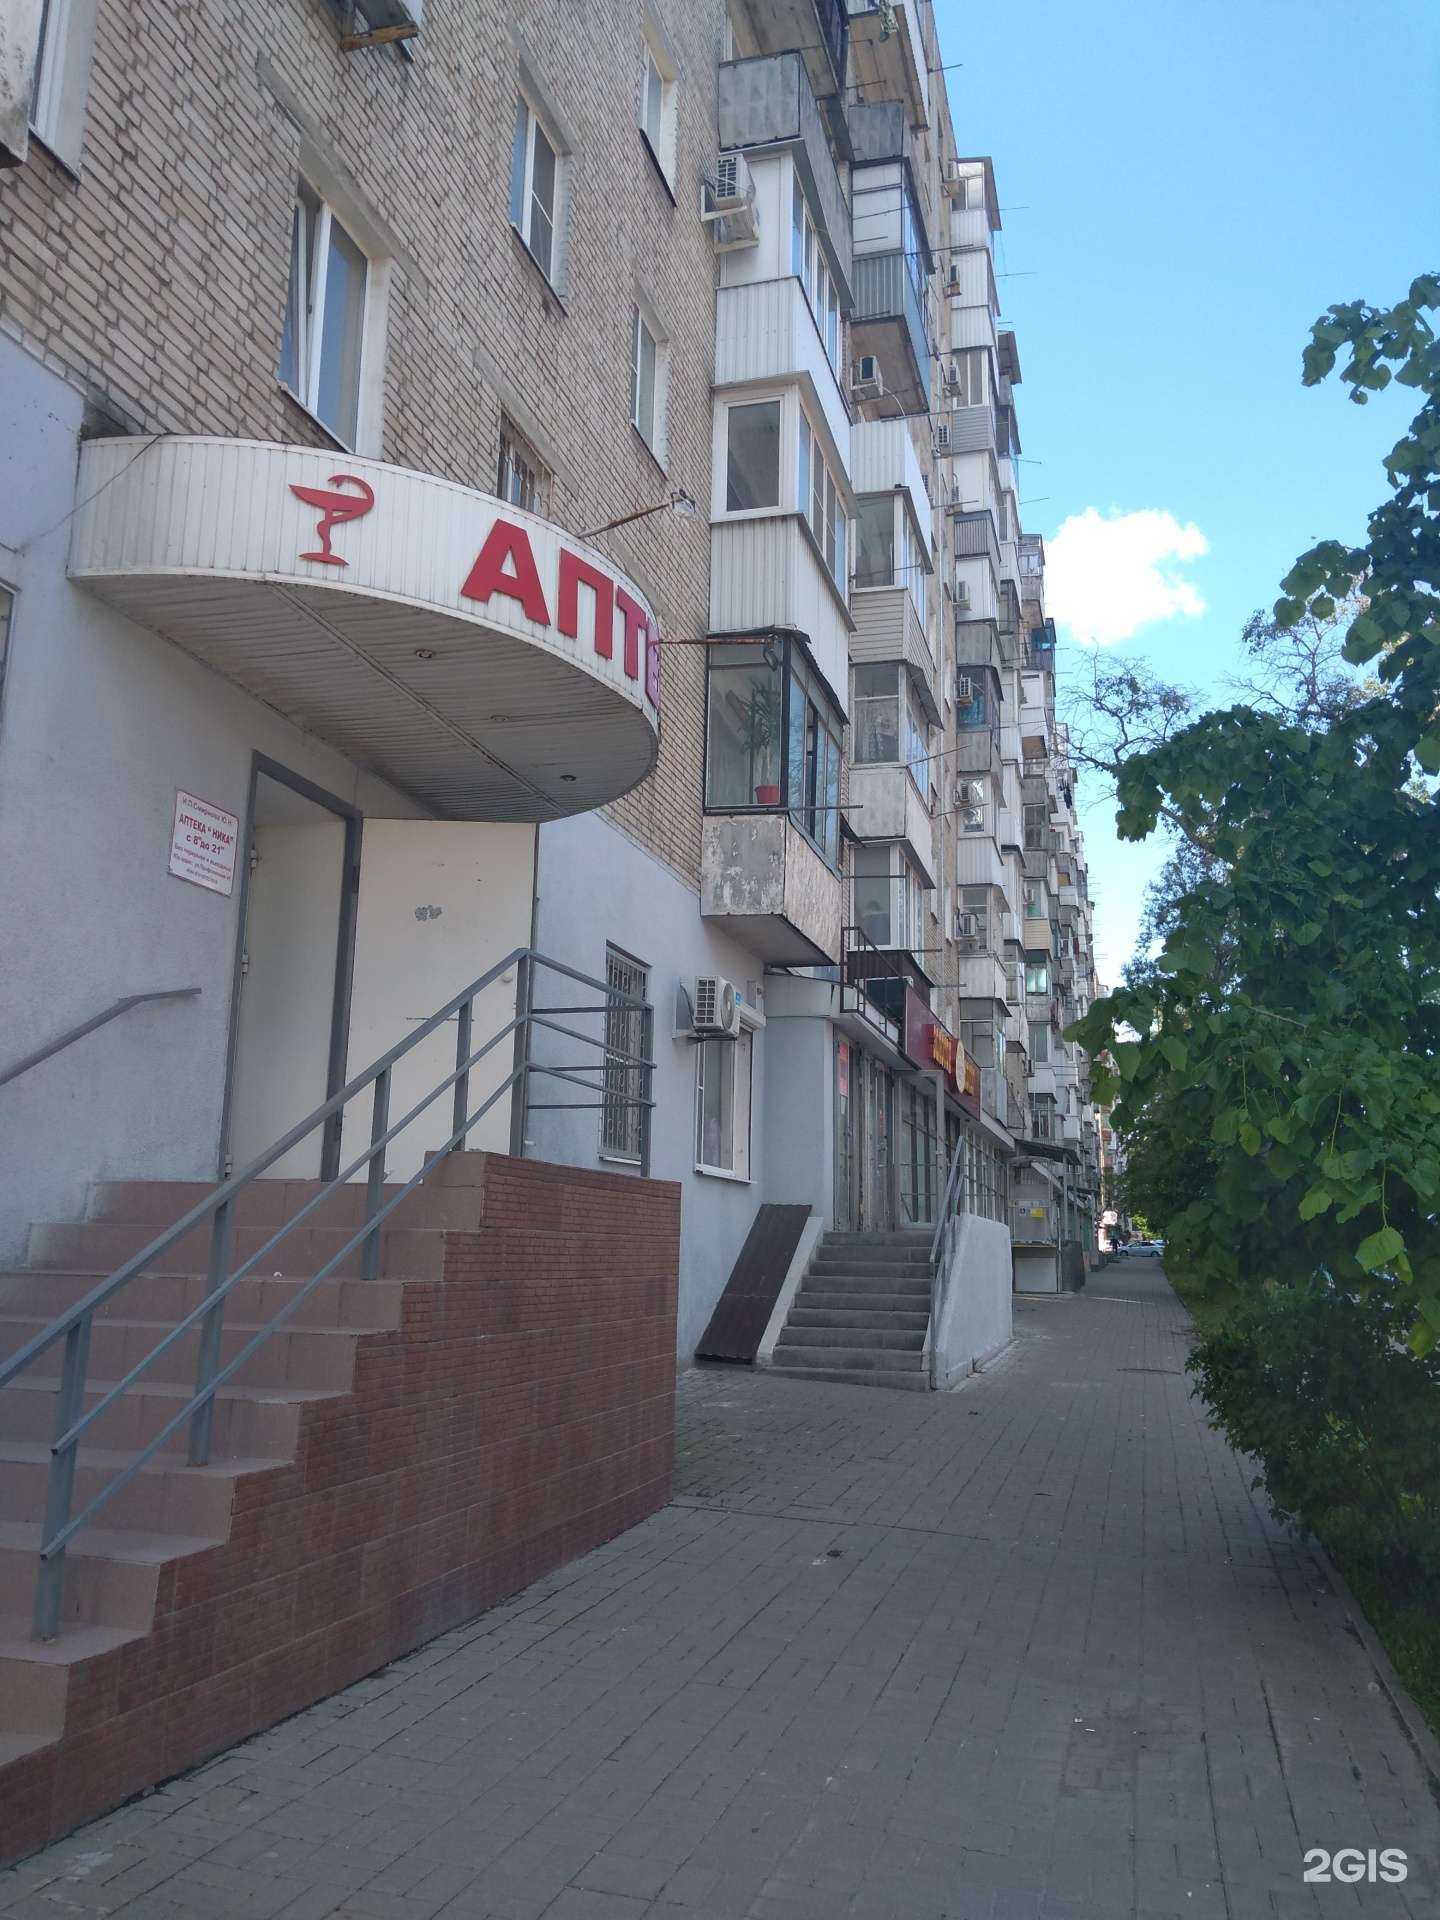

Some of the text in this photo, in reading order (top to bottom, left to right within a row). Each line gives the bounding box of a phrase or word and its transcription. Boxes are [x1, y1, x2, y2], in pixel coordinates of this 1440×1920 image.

[460, 517, 660, 712] АПТ
[179, 813, 206, 834] АПТЕКА
[200, 841, 210, 850] до
